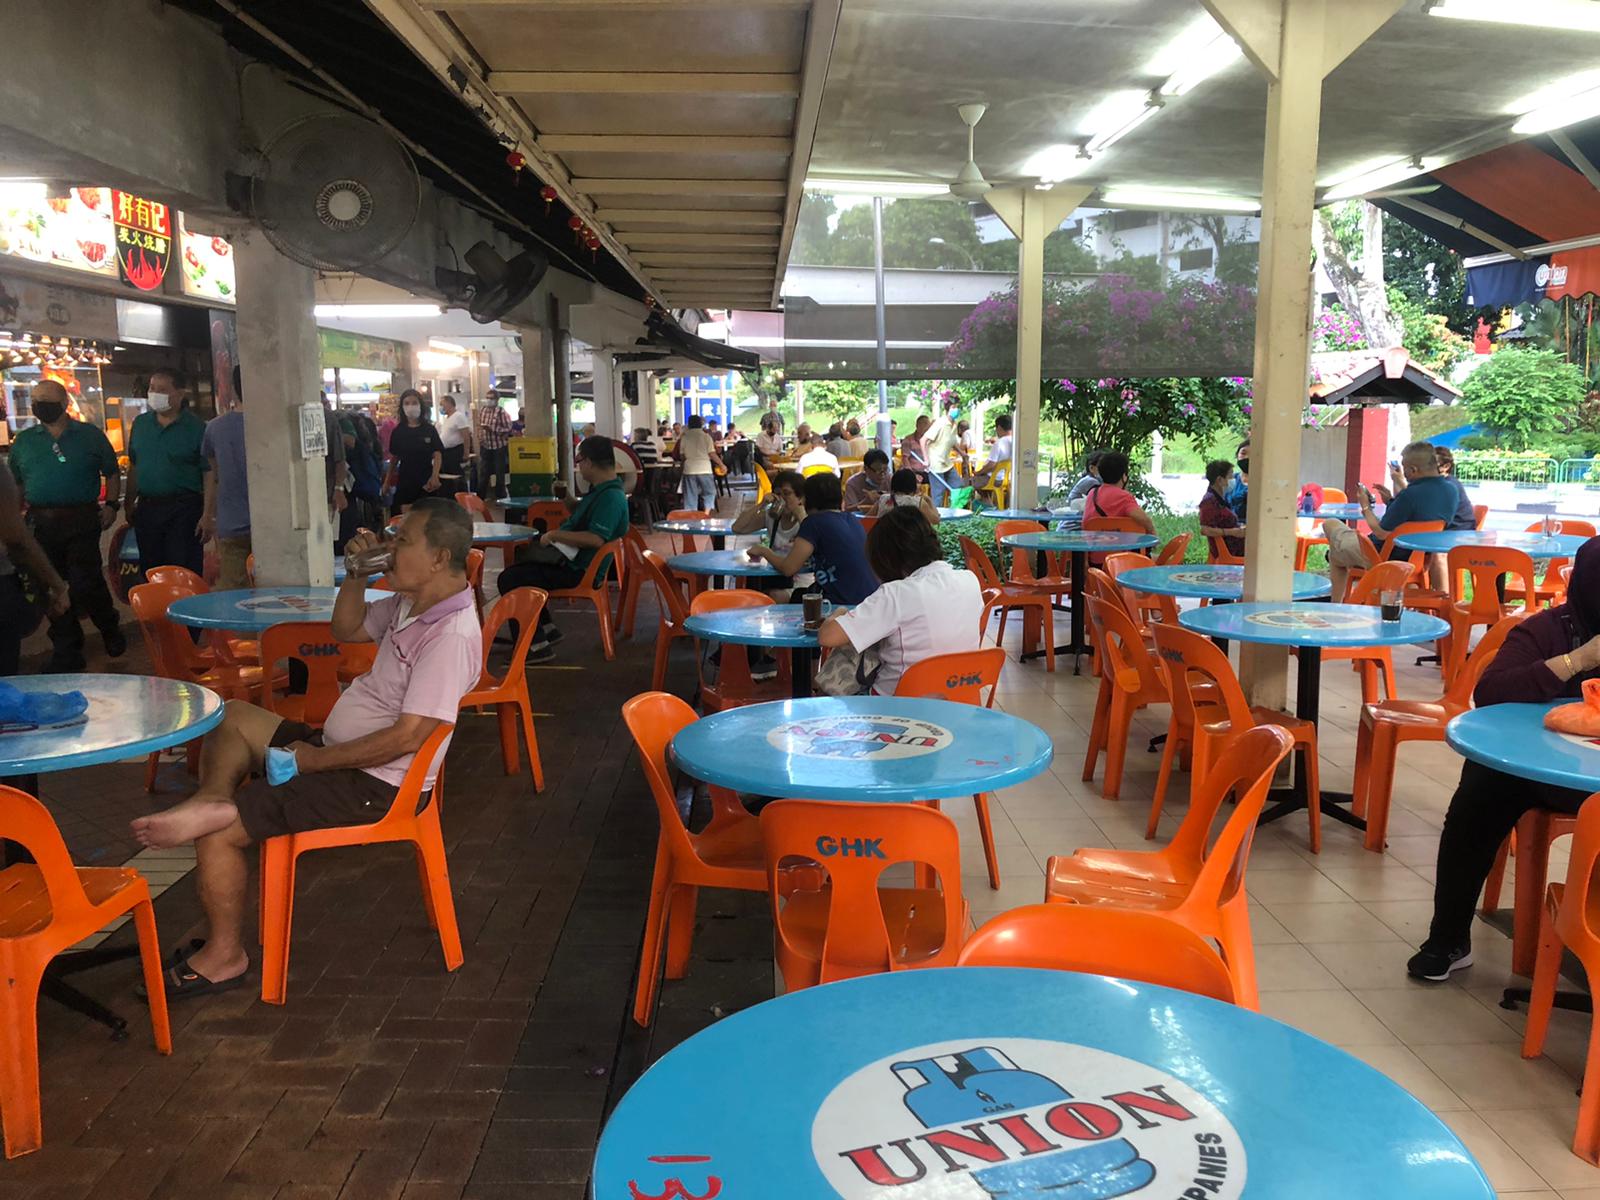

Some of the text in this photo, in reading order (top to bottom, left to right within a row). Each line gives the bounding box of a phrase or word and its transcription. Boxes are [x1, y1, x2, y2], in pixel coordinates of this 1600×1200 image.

[119, 191, 165, 234] 好有记
[298, 643, 341, 657] GHK
[946, 671, 983, 689] GHK
[815, 835, 889, 860] GHK
[982, 1102, 1016, 1114] GAS
[839, 1084, 1197, 1186] UNION
